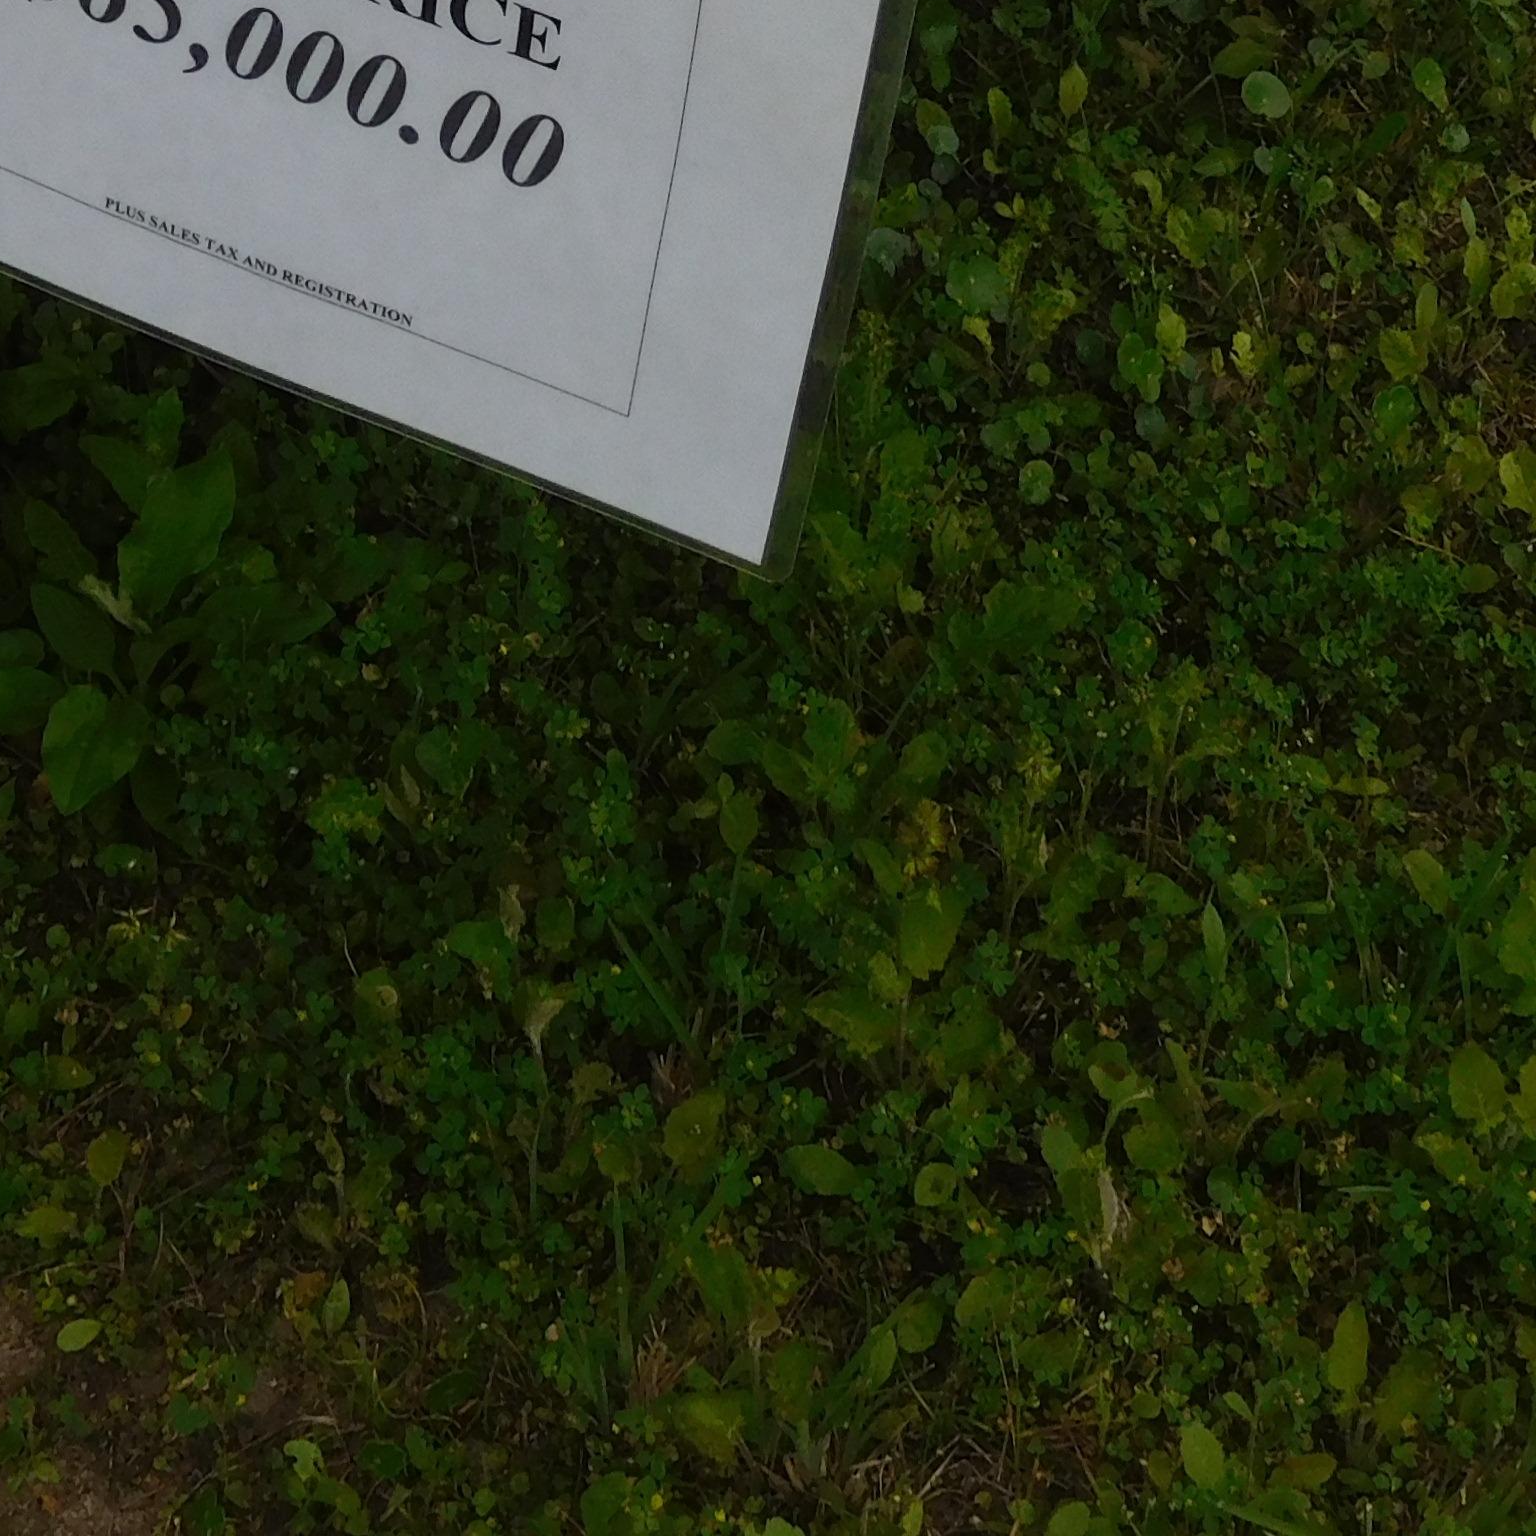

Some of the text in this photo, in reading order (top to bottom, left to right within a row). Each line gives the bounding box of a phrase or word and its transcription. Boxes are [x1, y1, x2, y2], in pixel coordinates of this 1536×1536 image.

[105, 197, 413, 327] PLUS SALES TAX AND REGISTRATION
